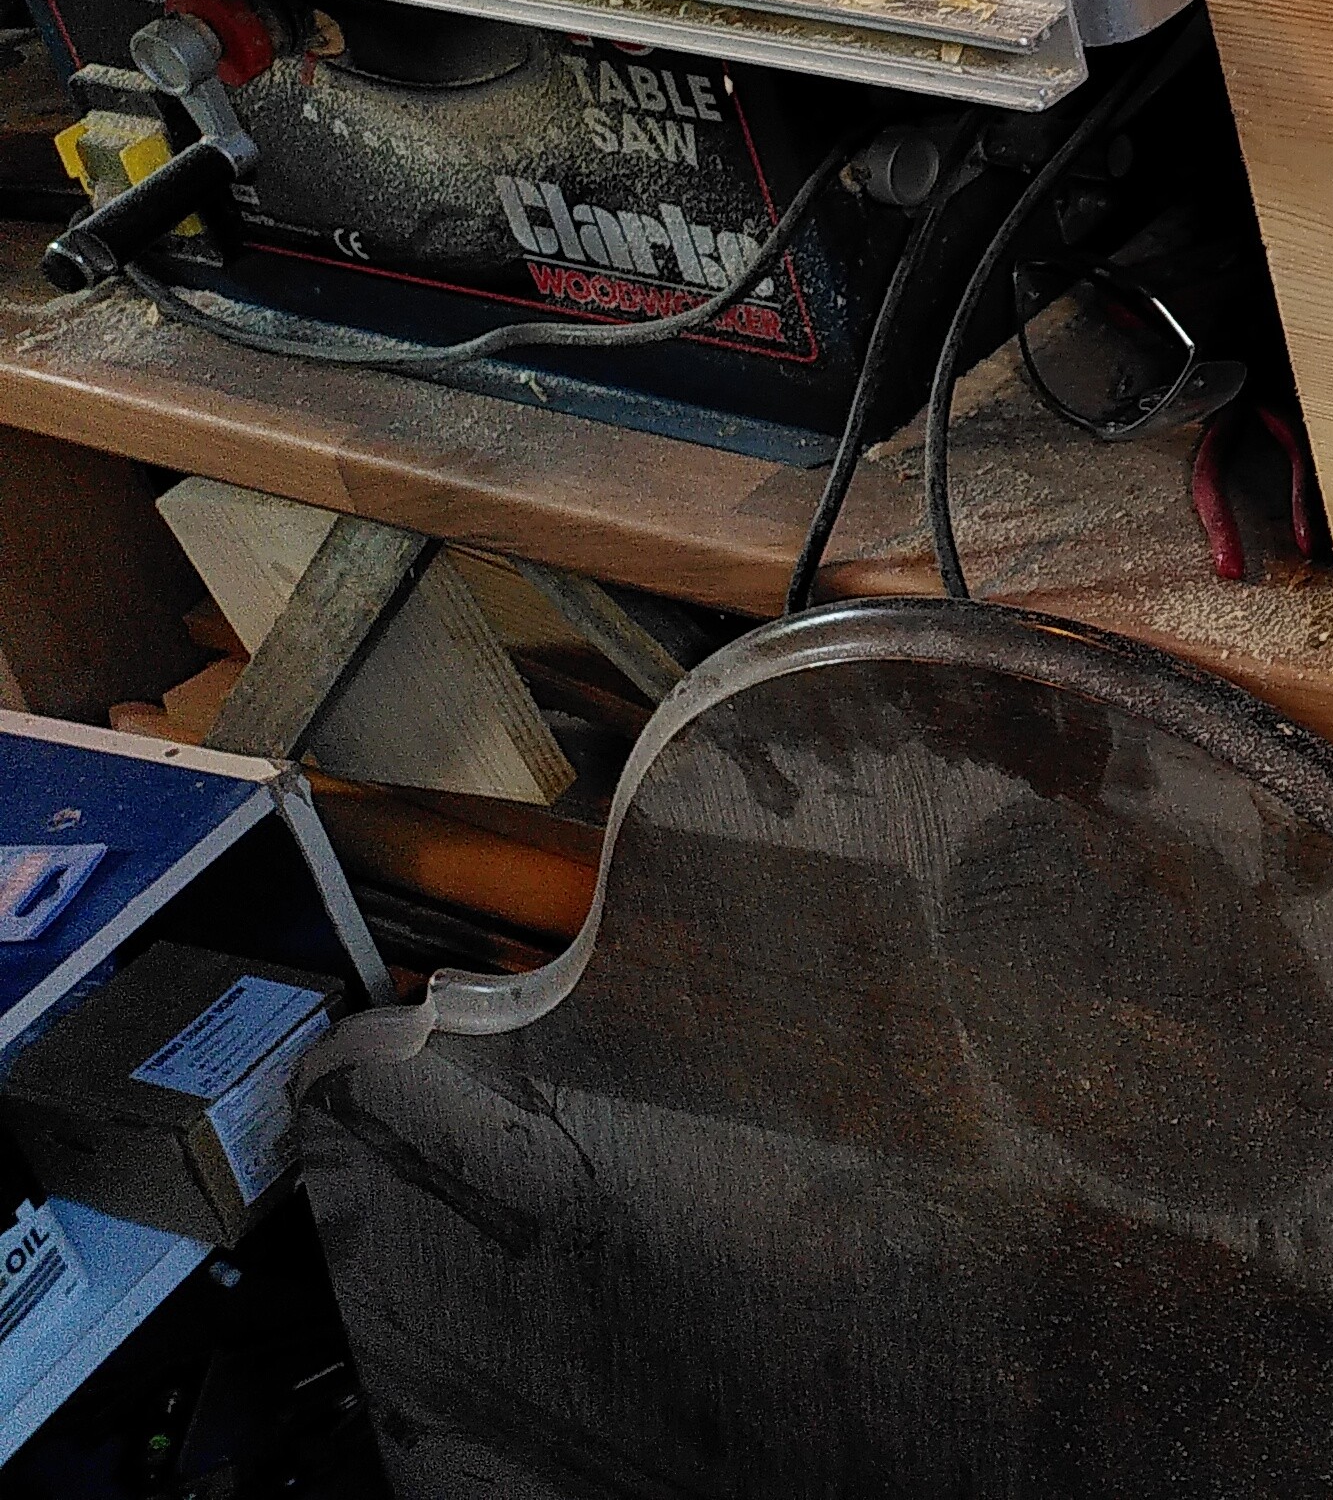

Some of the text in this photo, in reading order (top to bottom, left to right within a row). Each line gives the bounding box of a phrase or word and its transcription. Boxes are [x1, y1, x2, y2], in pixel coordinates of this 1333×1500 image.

[560, 55, 723, 122] TABLE
[582, 106, 699, 168] SAW
[495, 176, 774, 298] Clarke
[5, 1226, 50, 1275] OIL
